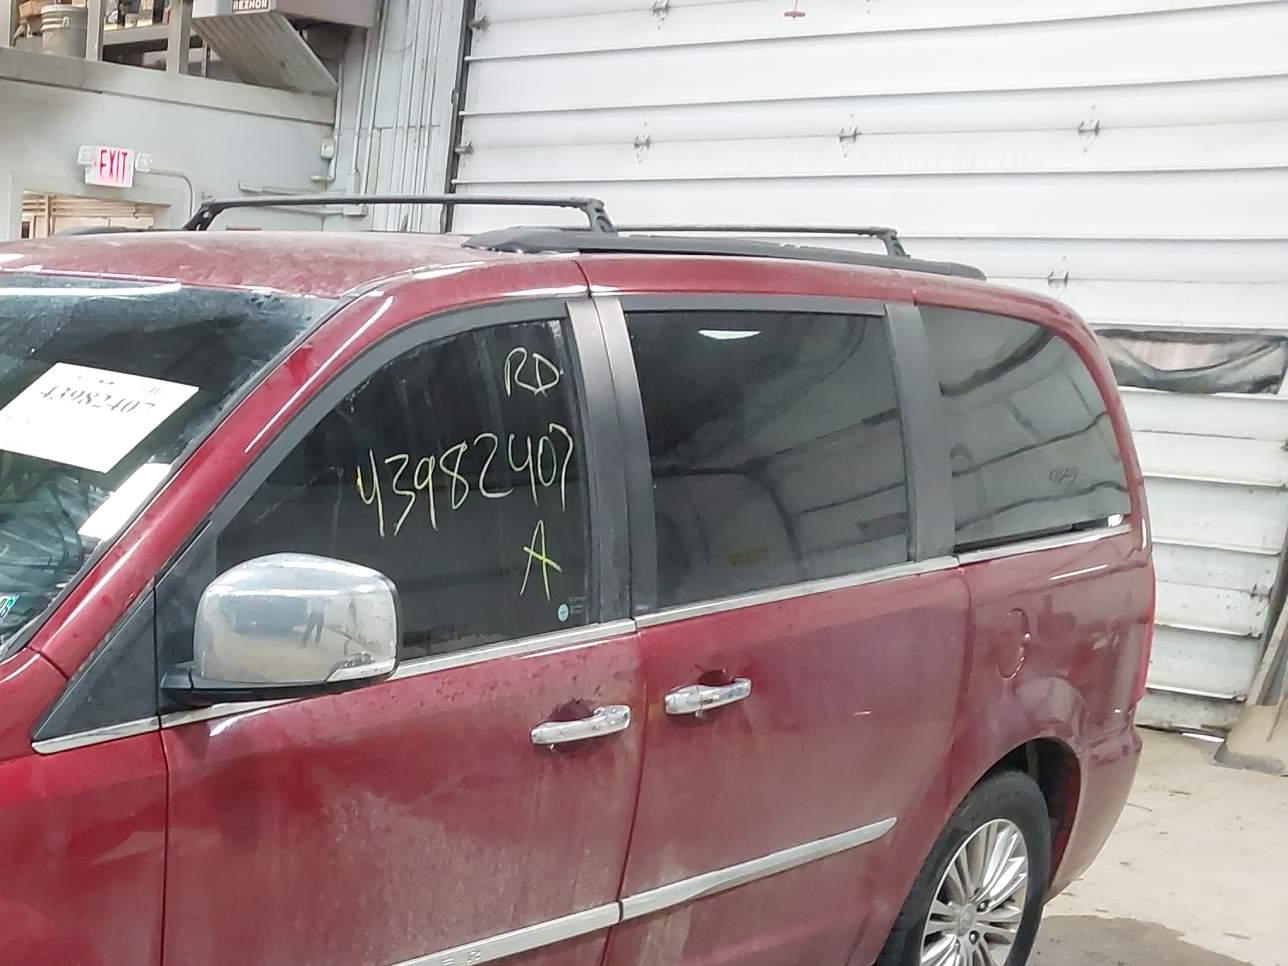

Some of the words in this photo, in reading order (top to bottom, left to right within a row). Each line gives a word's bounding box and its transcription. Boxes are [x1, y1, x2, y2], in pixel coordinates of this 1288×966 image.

[99, 149, 128, 184] EXIT
[356, 422, 574, 538] 43982407
[520, 519, 562, 601] A
